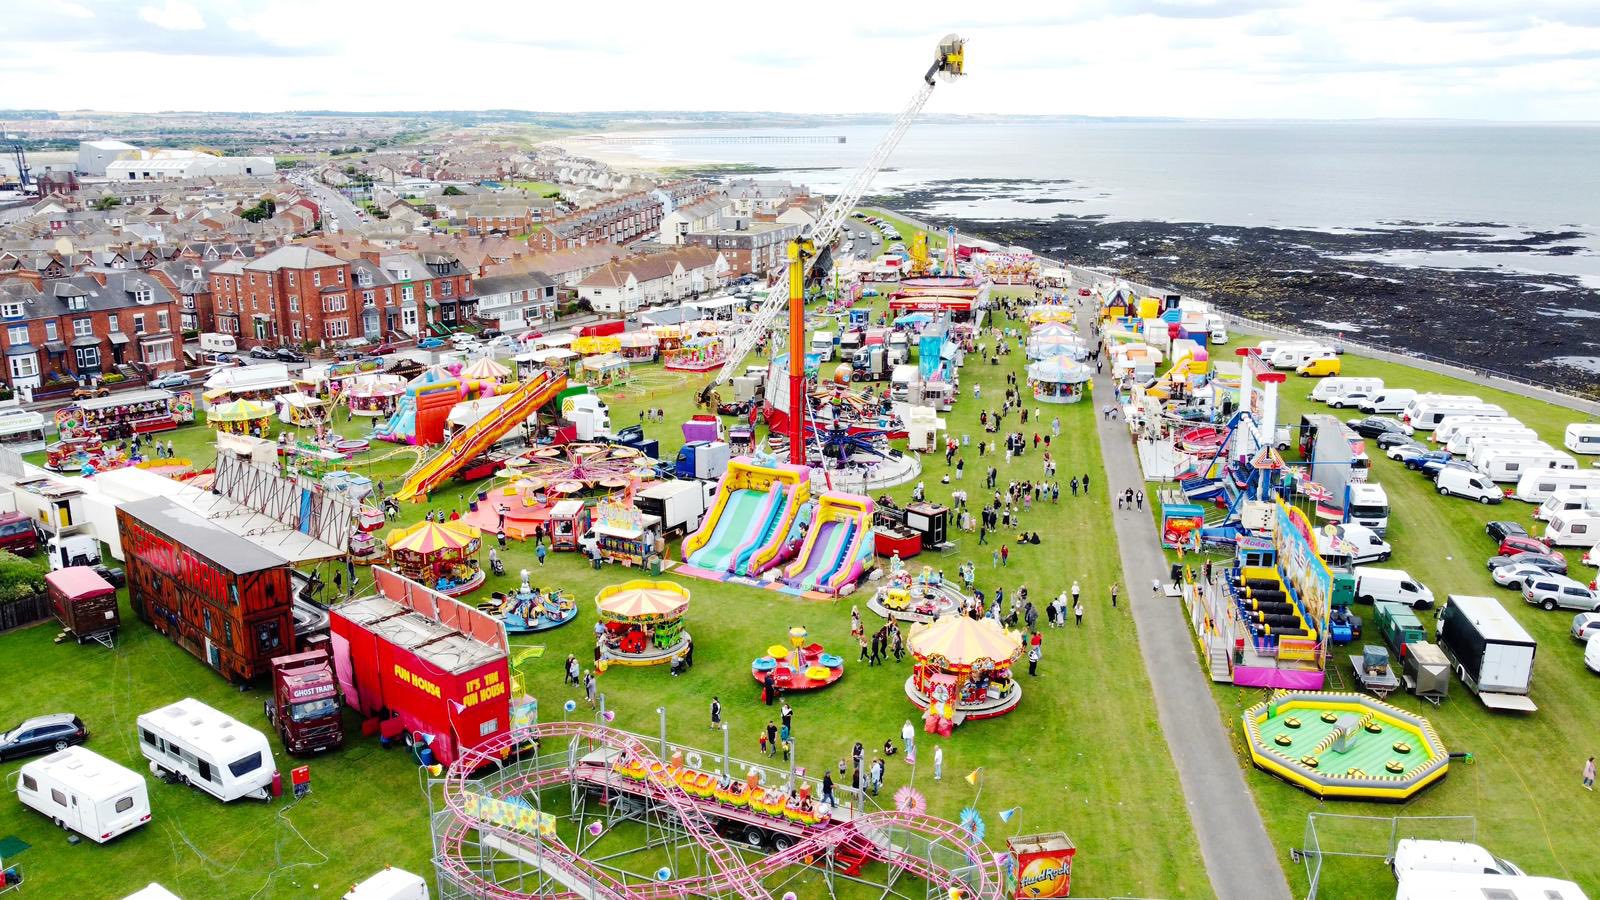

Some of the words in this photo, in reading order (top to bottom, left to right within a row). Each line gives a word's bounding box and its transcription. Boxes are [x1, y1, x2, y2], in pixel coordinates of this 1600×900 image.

[1244, 539, 1270, 549] Rodeo
[133, 523, 178, 577] GHOST
[182, 550, 228, 608] TRAIN
[294, 688, 314, 697] GHOST
[315, 684, 334, 694] TRAIN
[394, 664, 410, 682] FUN
[411, 673, 441, 699] HOUSE
[466, 678, 480, 693] IT'S
[463, 692, 478, 708] FUN
[480, 682, 505, 702] HOUSE
